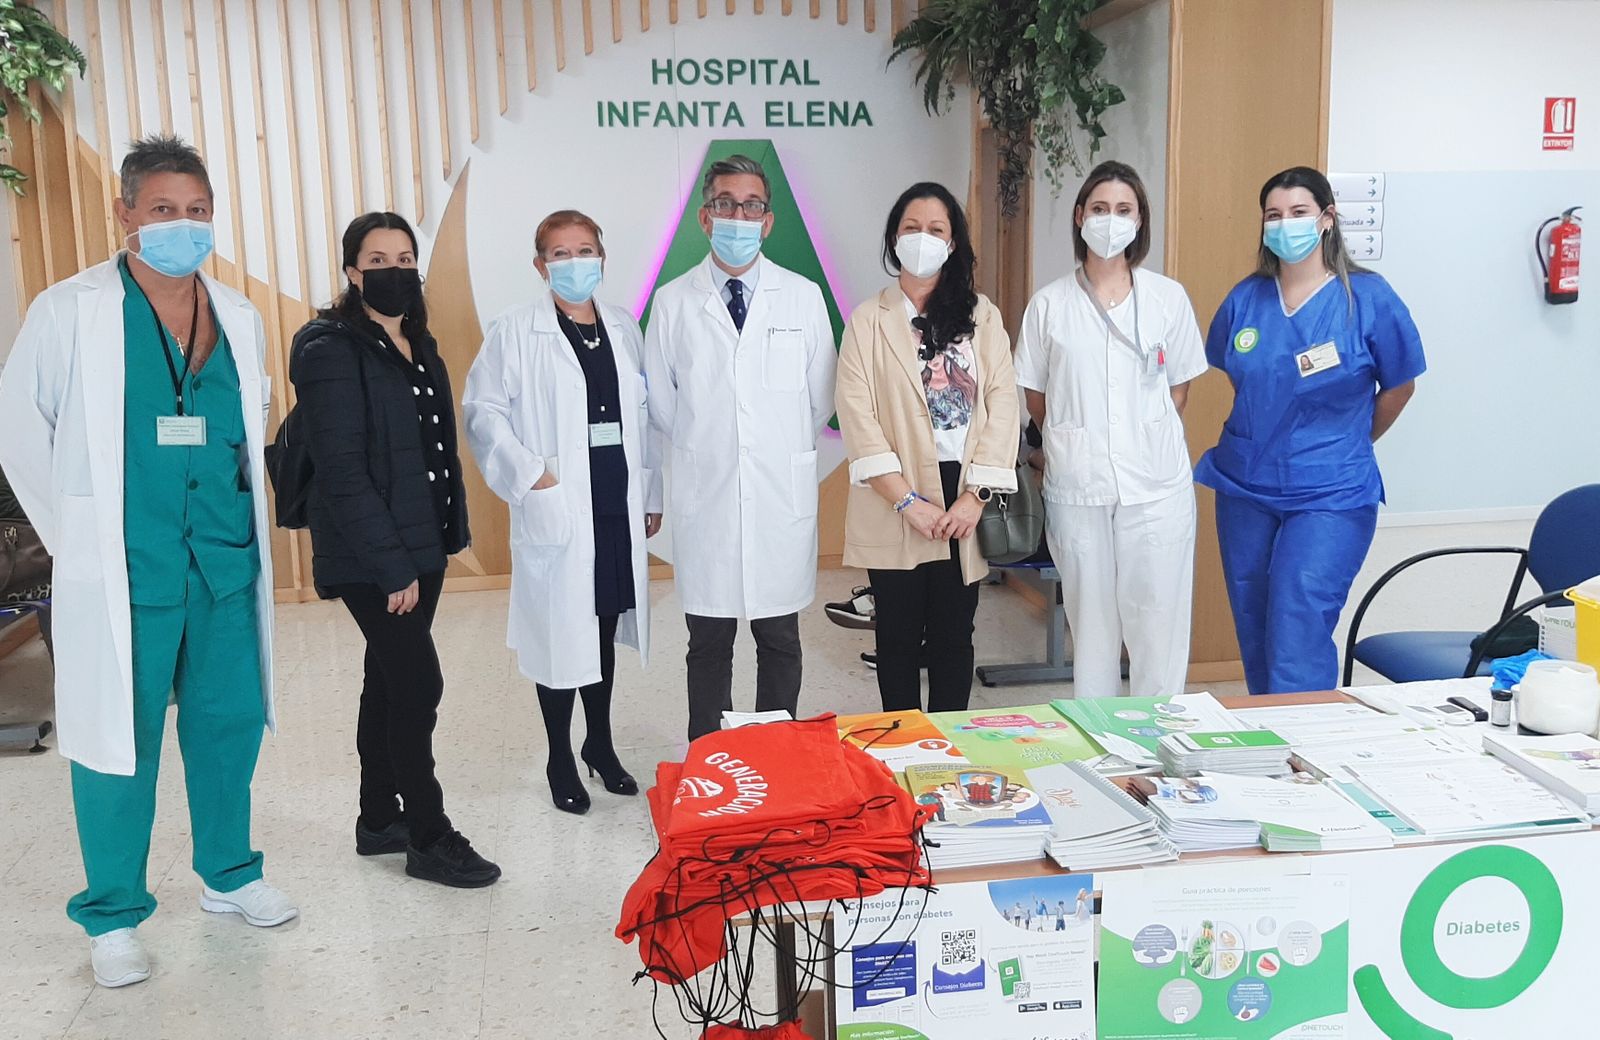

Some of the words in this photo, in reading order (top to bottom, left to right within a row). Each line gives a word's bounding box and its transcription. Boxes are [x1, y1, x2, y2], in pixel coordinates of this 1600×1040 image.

[651, 58, 820, 86] HOSPITAL
[597, 101, 745, 127] INFANTA
[764, 101, 873, 127] ELENA
[697, 752, 768, 817] GENERACIÓN
[1227, 885, 1236, 893] de
[847, 899, 896, 911] Consejos
[848, 915, 891, 927] prsonas
[913, 910, 953, 920] dabetes
[1446, 919, 1521, 936] Diabetes
[959, 981, 984, 989] Diabetes
